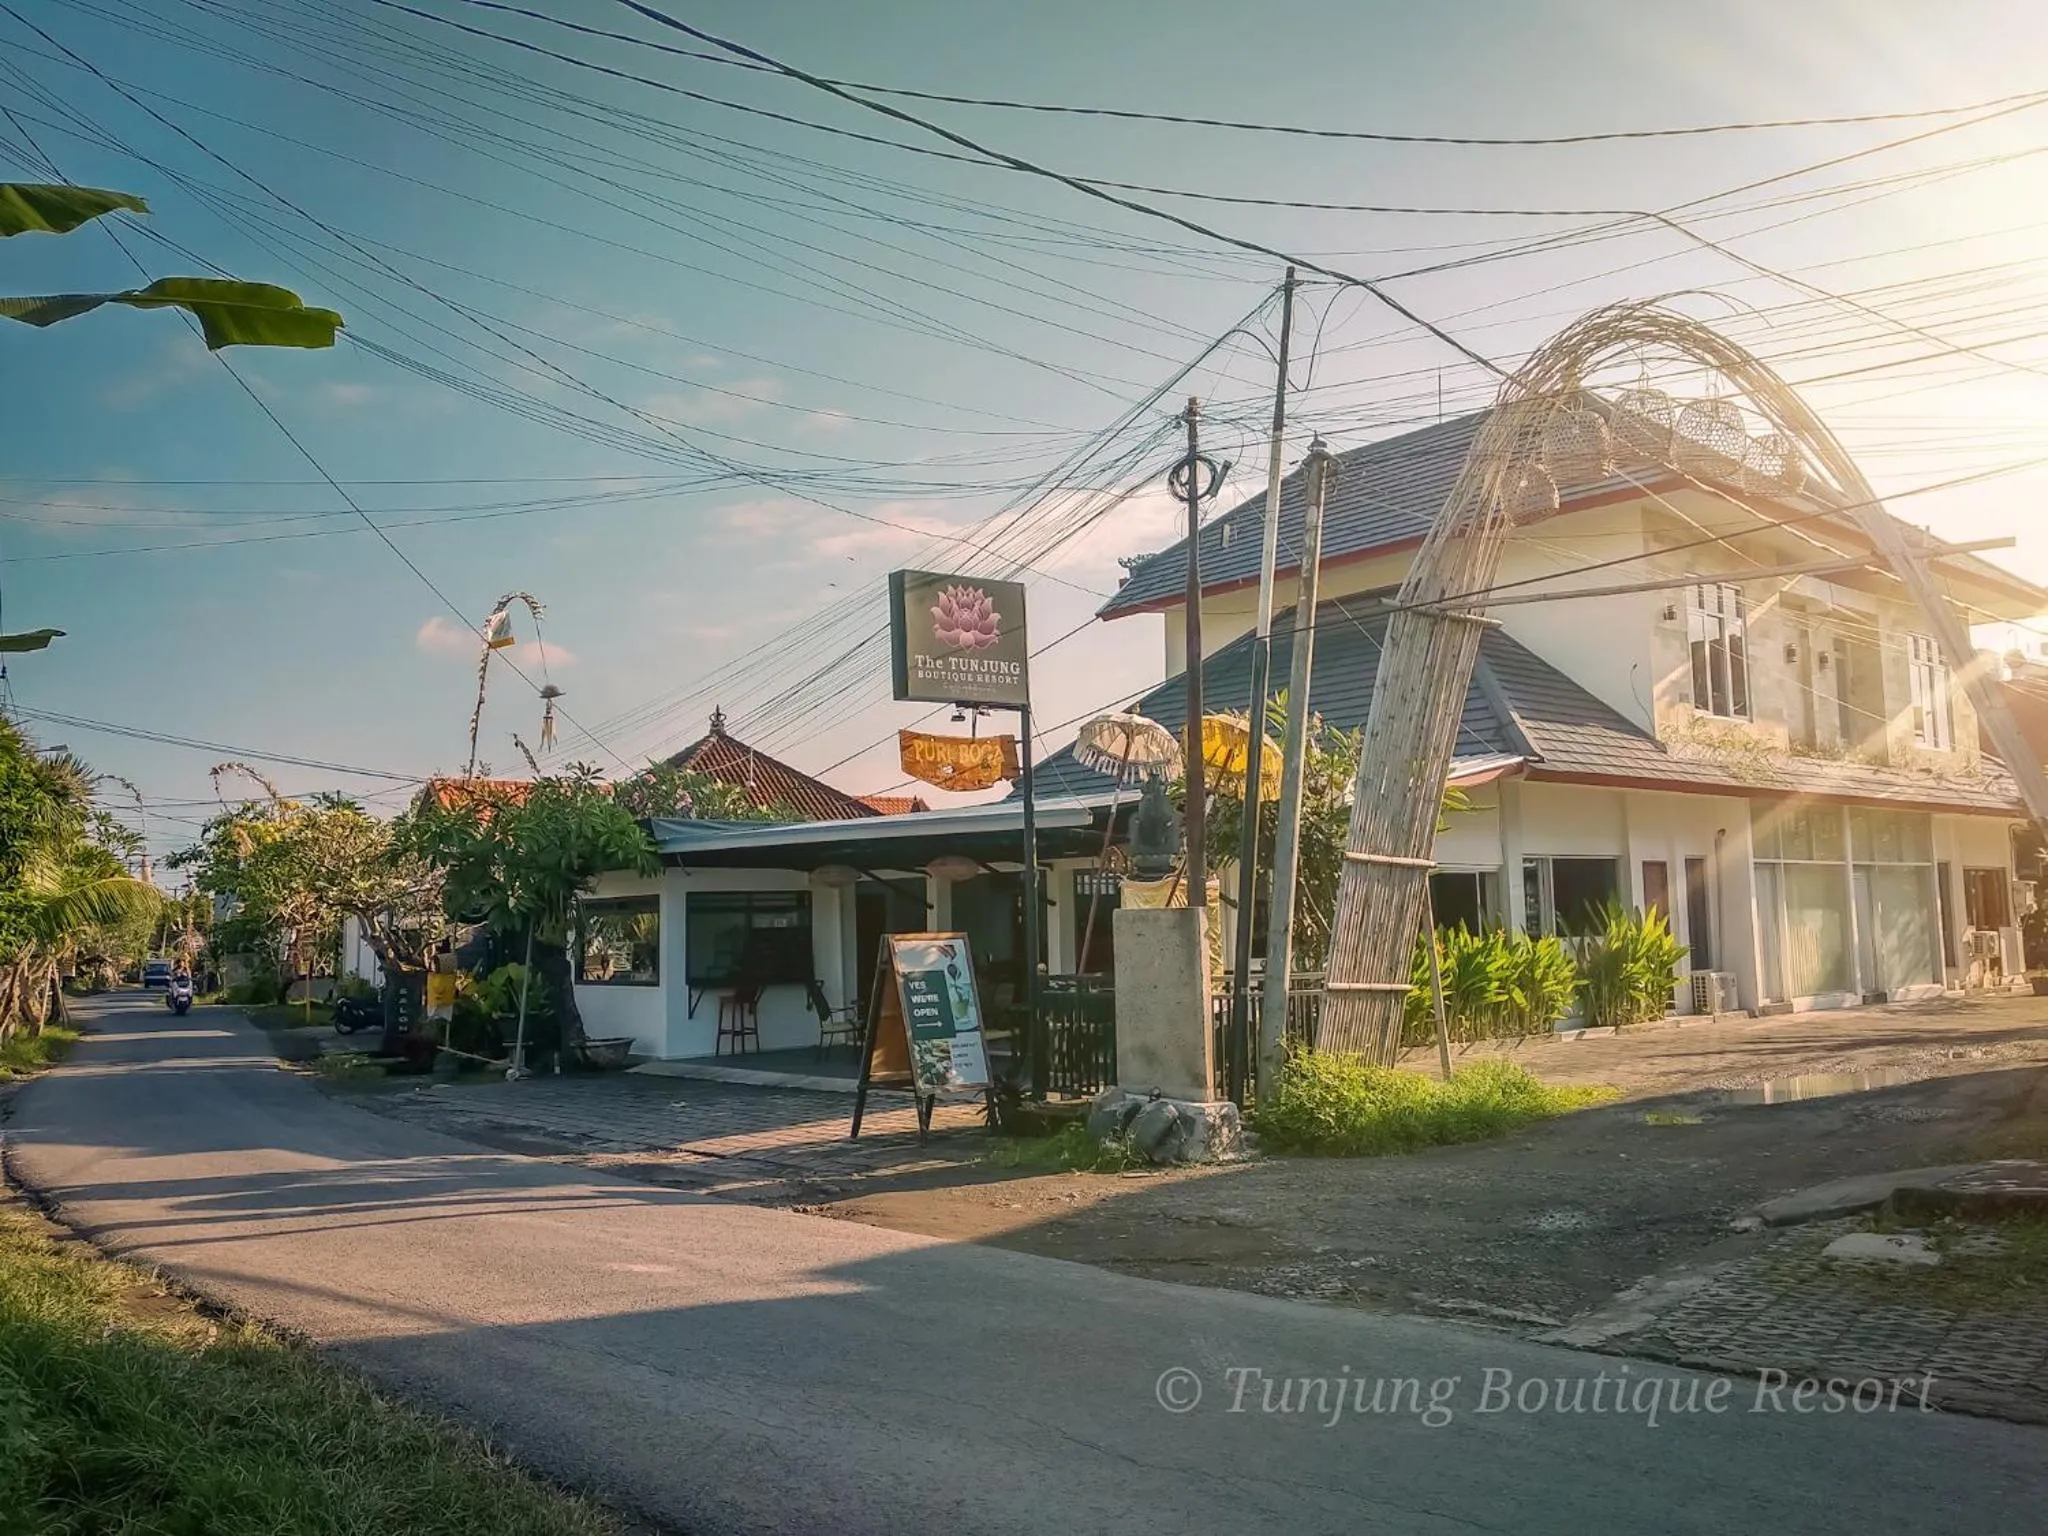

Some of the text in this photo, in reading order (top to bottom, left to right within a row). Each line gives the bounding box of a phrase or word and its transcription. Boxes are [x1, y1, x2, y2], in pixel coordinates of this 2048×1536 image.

[915, 654, 1021, 675] The TUNJUNG
[918, 670, 1019, 685] BOUTIQUE RESORT
[908, 981, 926, 990] YES
[913, 1008, 939, 1017] OPEN
